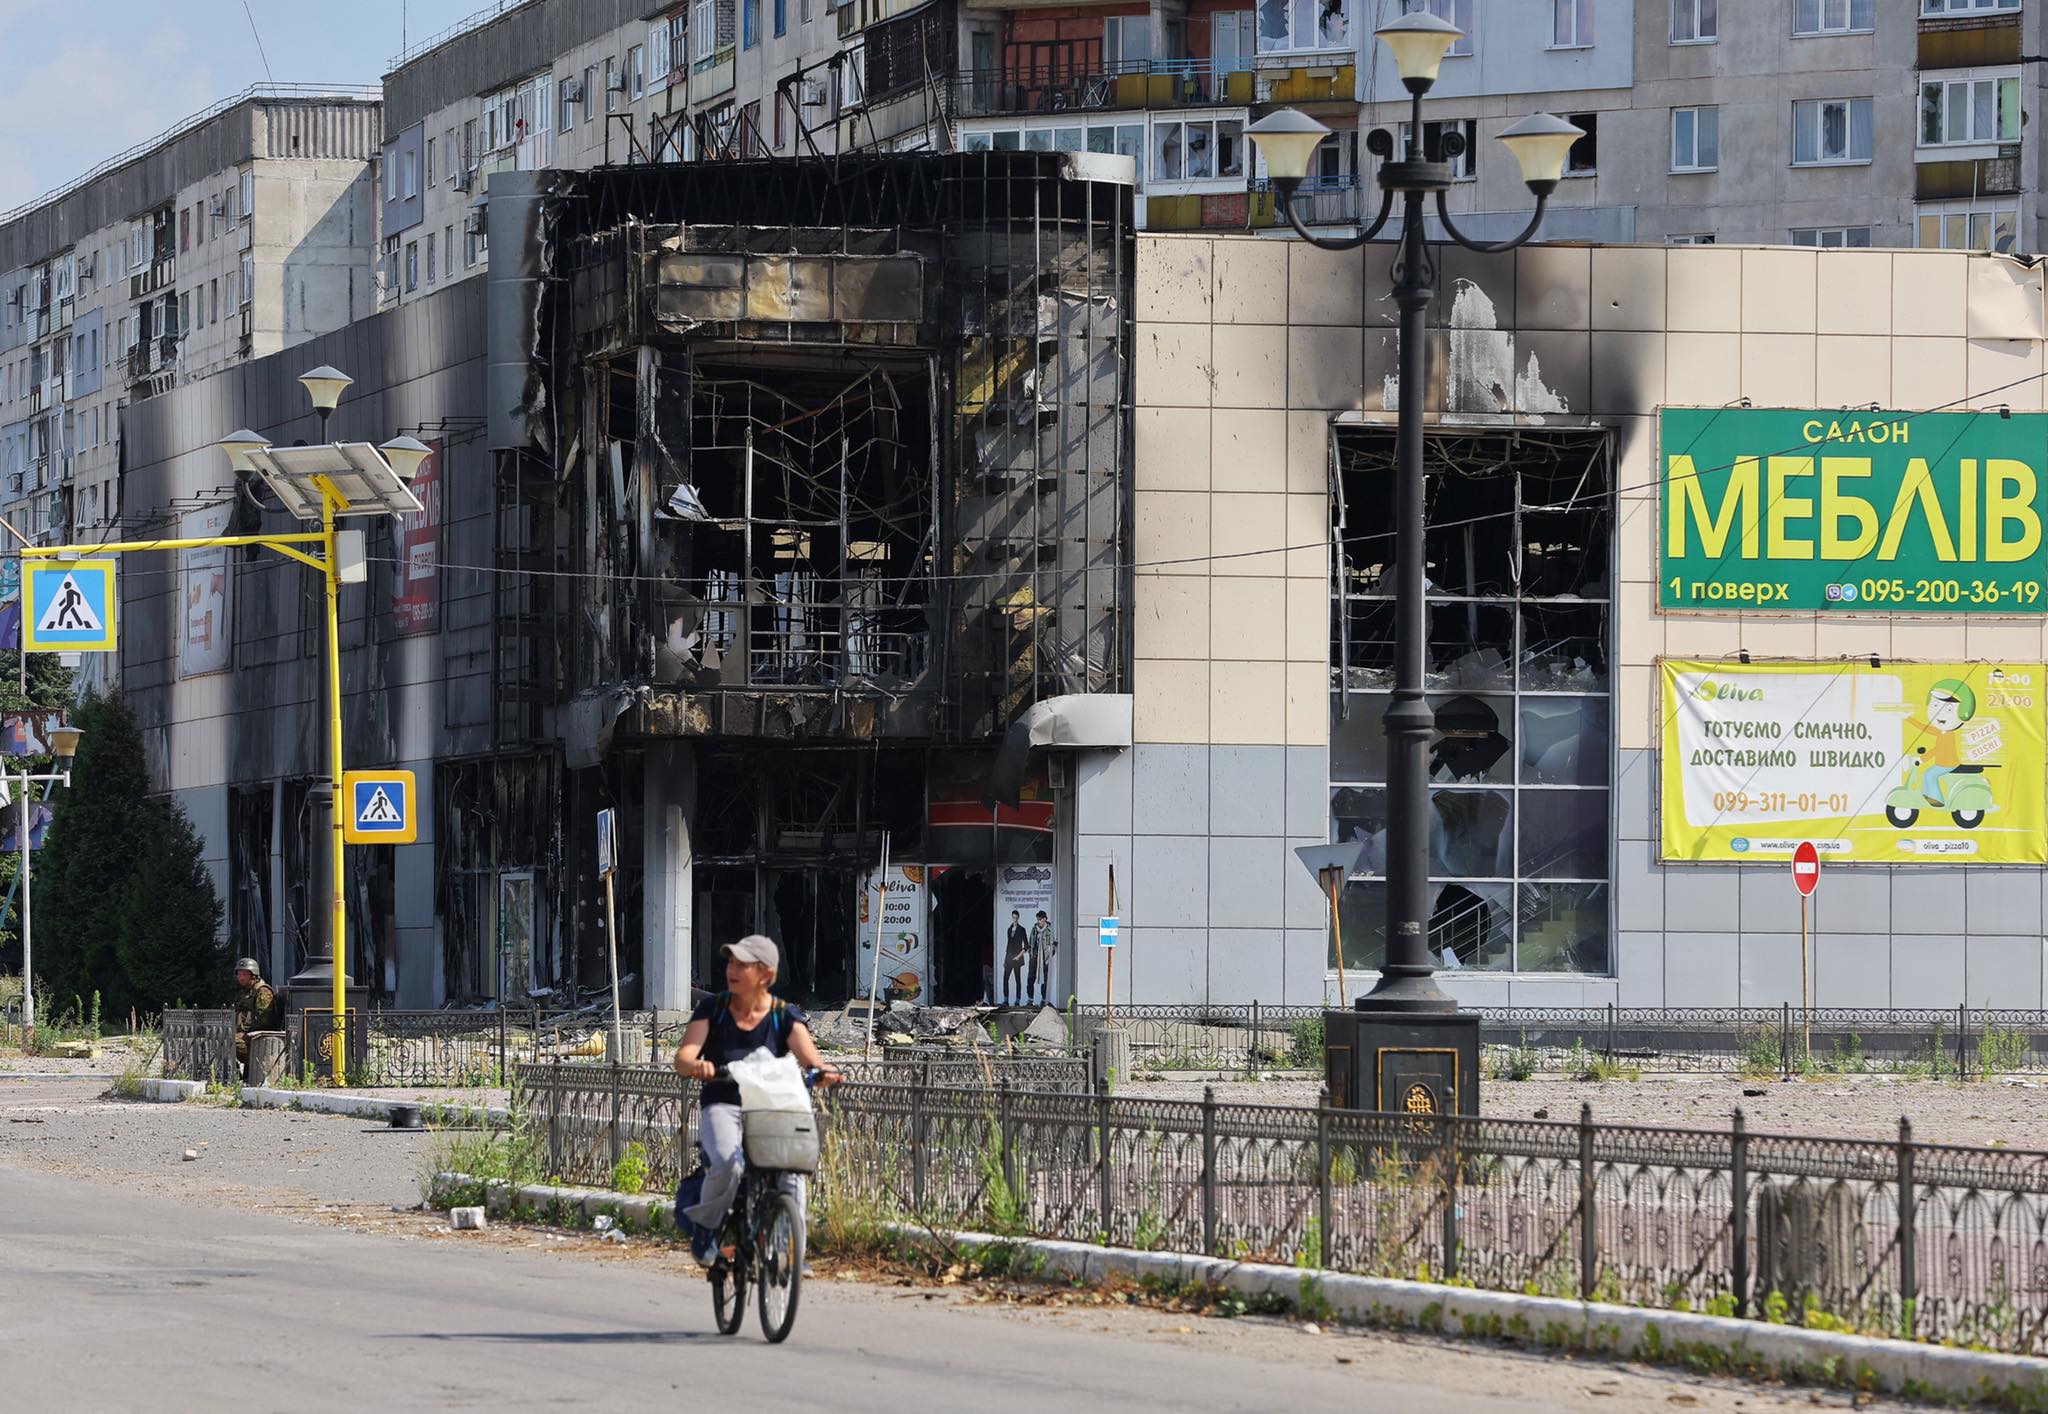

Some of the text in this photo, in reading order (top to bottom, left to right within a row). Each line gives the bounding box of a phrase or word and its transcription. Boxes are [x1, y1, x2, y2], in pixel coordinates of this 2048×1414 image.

[1803, 420, 1909, 443] САЛОН
[1668, 455, 2042, 562] МЕБЛІВ
[1669, 576, 1790, 605] 1 поверх
[1861, 579, 2040, 604] 095-200-36-19
[1703, 721, 1782, 739] ГОТУЄМО
[1970, 723, 1998, 741] PIZZA
[1971, 739, 1999, 758] SUSHI
[1690, 749, 1886, 769] ДОСТАВИМО ШВИДКО
[1713, 791, 1849, 813] 099-311-01-01
[879, 880, 916, 893] liva
[885, 903, 911, 911] 10:00
[884, 916, 912, 924] 20:00
